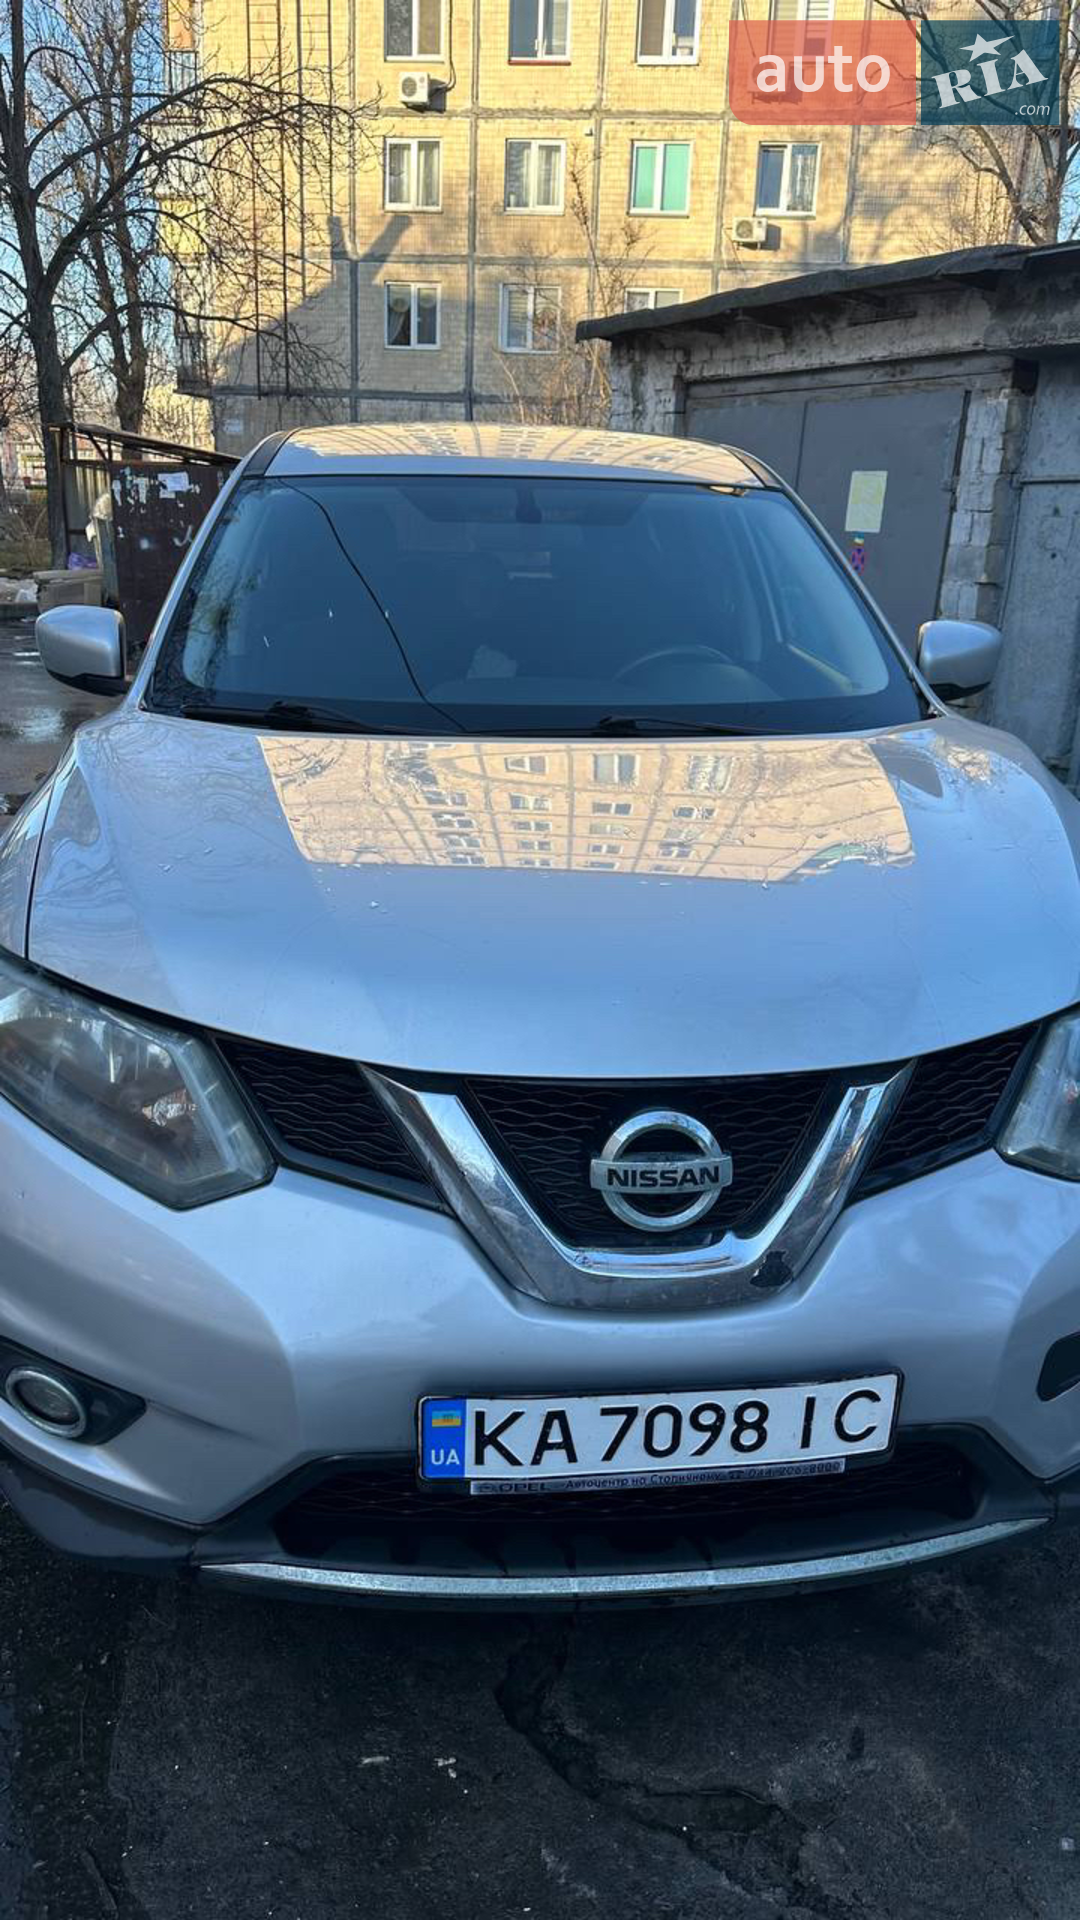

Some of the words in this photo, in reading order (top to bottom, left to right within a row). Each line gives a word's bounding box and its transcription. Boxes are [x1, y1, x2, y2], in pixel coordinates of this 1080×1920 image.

[607, 1165, 720, 1188] NISSAN
[473, 1409, 579, 1467] KA
[599, 1399, 770, 1462] 7098
[799, 1388, 882, 1449] IC
[431, 1449, 460, 1466] UA
[499, 1482, 552, 1493] OPEL
